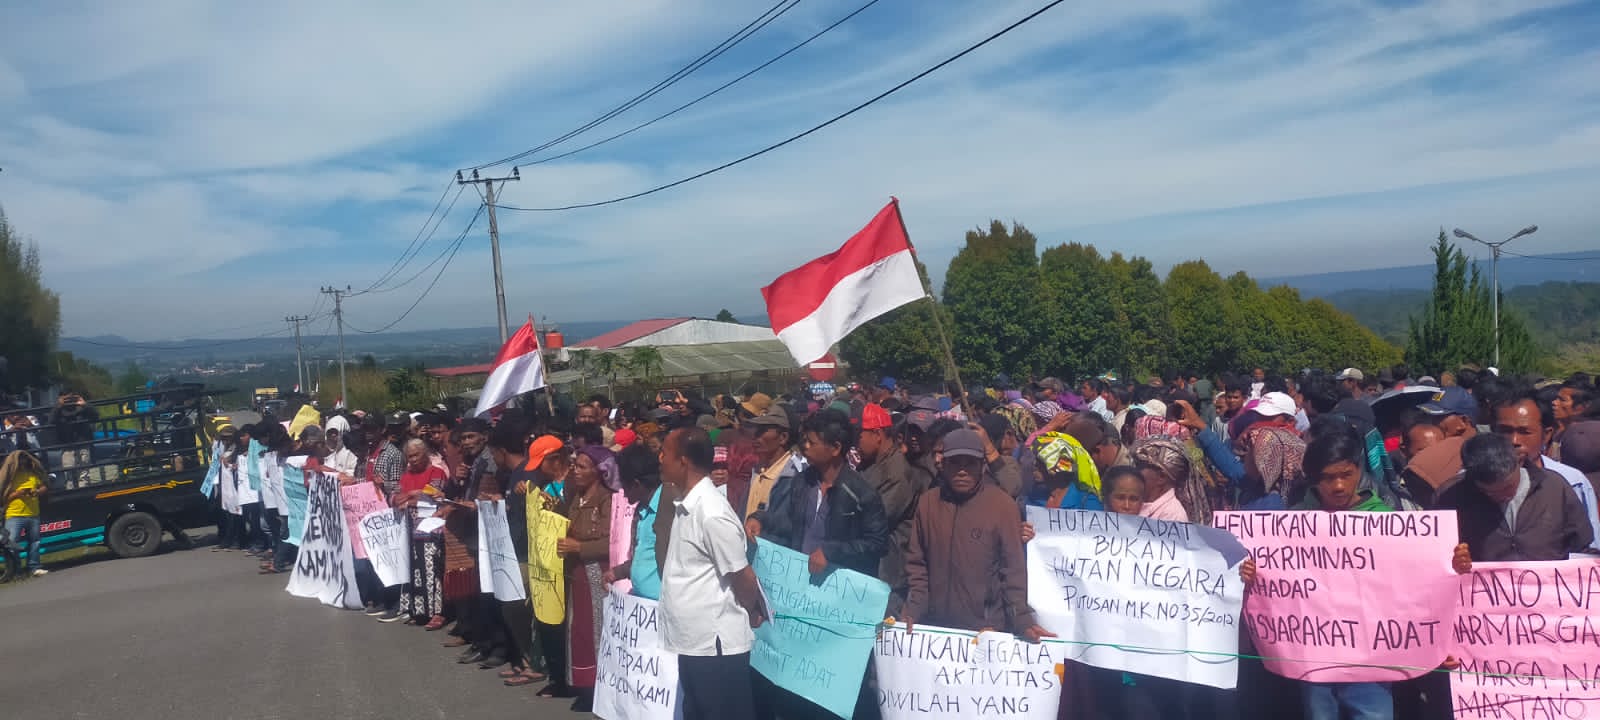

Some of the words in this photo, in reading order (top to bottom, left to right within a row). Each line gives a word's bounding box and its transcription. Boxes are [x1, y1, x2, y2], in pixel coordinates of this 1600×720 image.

[1048, 509, 1120, 532] HUTAN
[1136, 517, 1193, 541] ADAT
[1214, 512, 1317, 538] HENTIKAN
[1328, 513, 1439, 538] INTIMIDASI
[1093, 535, 1176, 561] BUKAN
[1052, 556, 1121, 583] HUTAN
[1133, 562, 1226, 598] NEGARA
[1063, 585, 1120, 614] PUTUSAN
[627, 603, 658, 632] ADA
[1373, 619, 1441, 650] ADAT
[935, 666, 1053, 690] AKTIVITAS
[1458, 657, 1548, 689] MARGA
[636, 679, 671, 708] KAMI
[971, 696, 1029, 715] YANG
